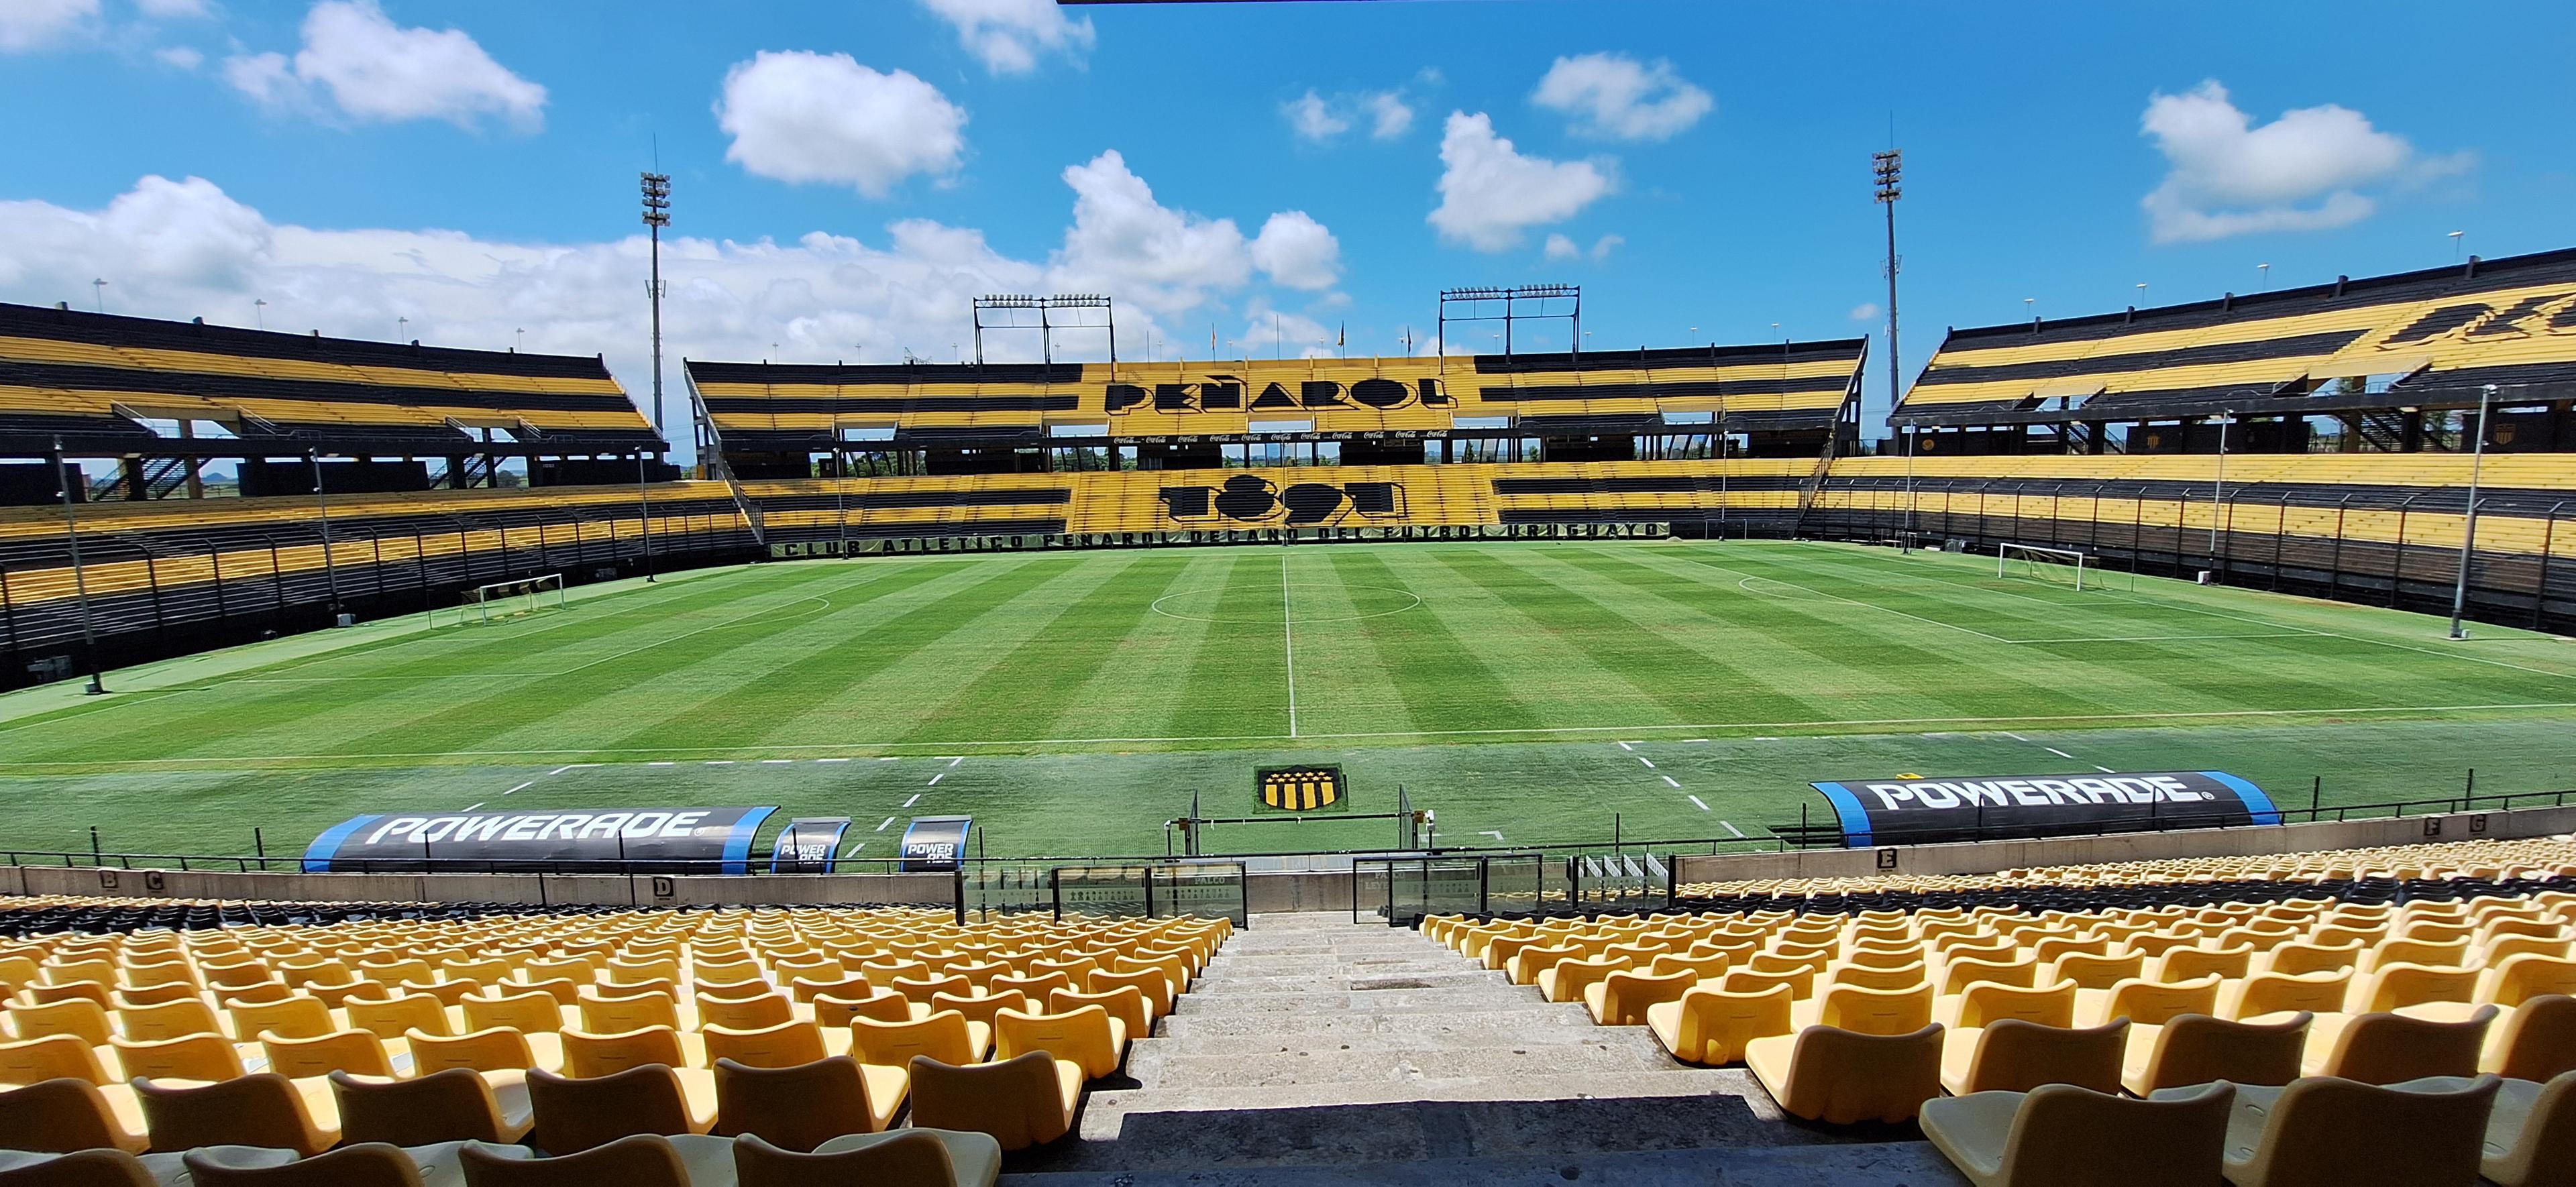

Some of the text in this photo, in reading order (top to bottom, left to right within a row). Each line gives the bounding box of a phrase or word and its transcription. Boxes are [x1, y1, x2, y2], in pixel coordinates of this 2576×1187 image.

[1159, 474, 1408, 528] 1891
[784, 541, 860, 556] CLUB
[882, 535, 1023, 552] ATLETICO
[1190, 528, 1298, 543] DECANO
[1318, 527, 1363, 540] DEL
[1384, 525, 1487, 537] FUTBOL
[1507, 524, 1657, 537] URUGUAYO
[781, 844, 826, 855] POWER
[908, 843, 954, 854] POWER
[1880, 850, 1894, 867] E
[101, 871, 116, 887] B
[148, 872, 162, 889] C
[655, 879, 671, 895] D
[1194, 877, 1225, 885] PALCO
